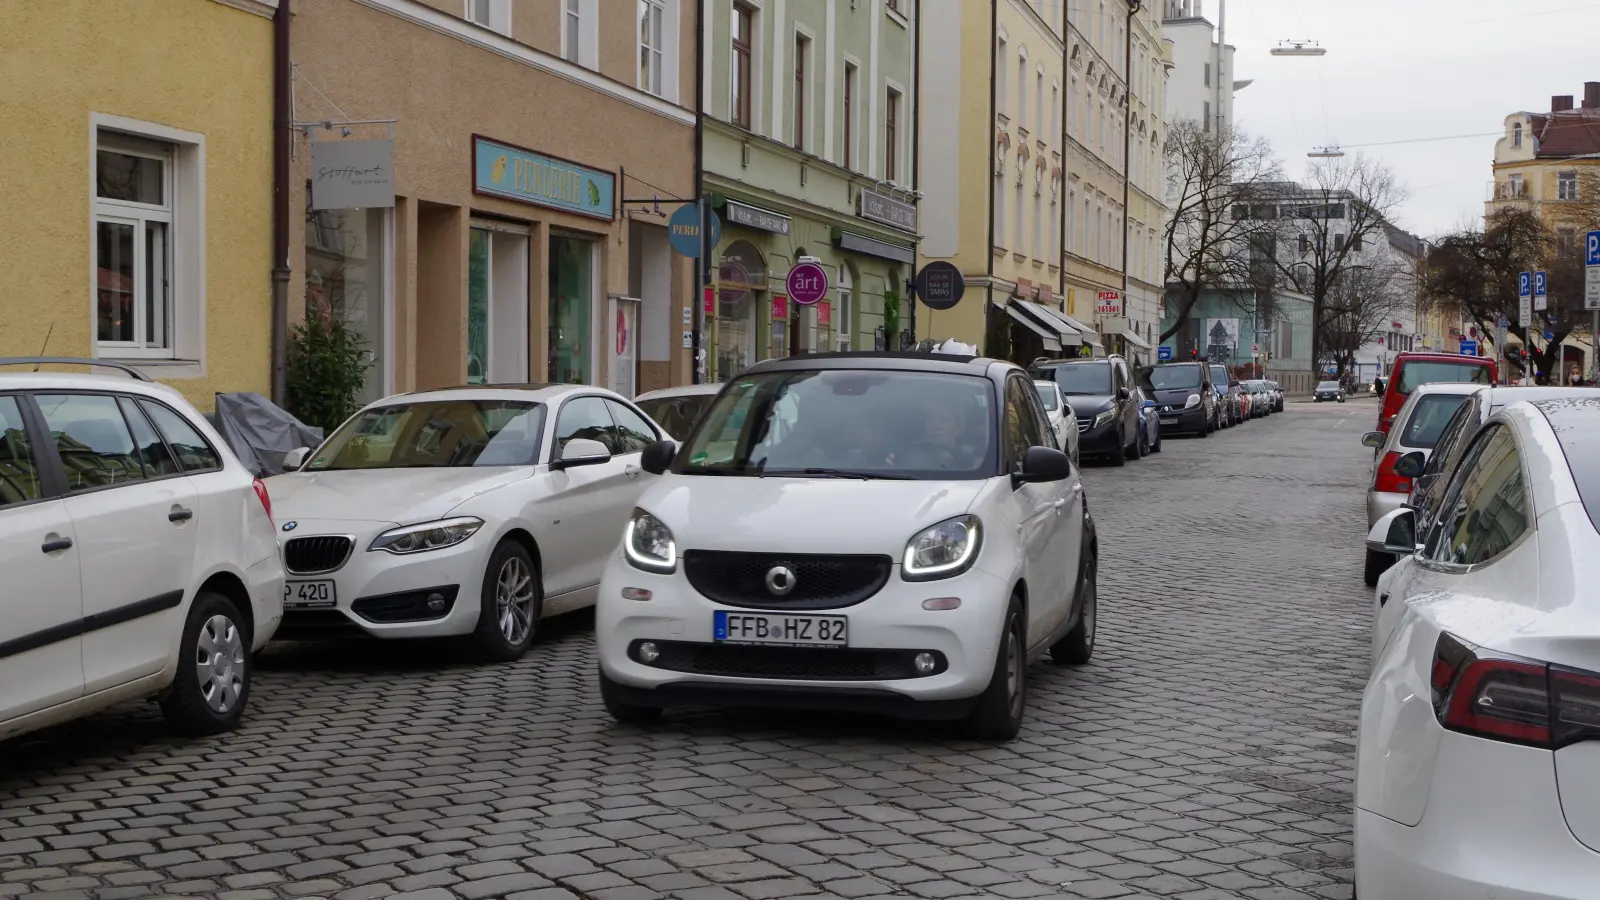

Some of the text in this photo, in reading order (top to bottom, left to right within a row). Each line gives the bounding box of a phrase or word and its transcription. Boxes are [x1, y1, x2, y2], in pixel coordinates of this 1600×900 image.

[513, 157, 582, 204] PERLERIE
[1588, 236, 1598, 261] P
[795, 276, 819, 290] art
[1521, 275, 1528, 293] P
[1536, 274, 1543, 293] P
[1098, 291, 1119, 300] PIZZA
[298, 583, 328, 600] 420
[728, 616, 845, 641] FFB HZ 82
